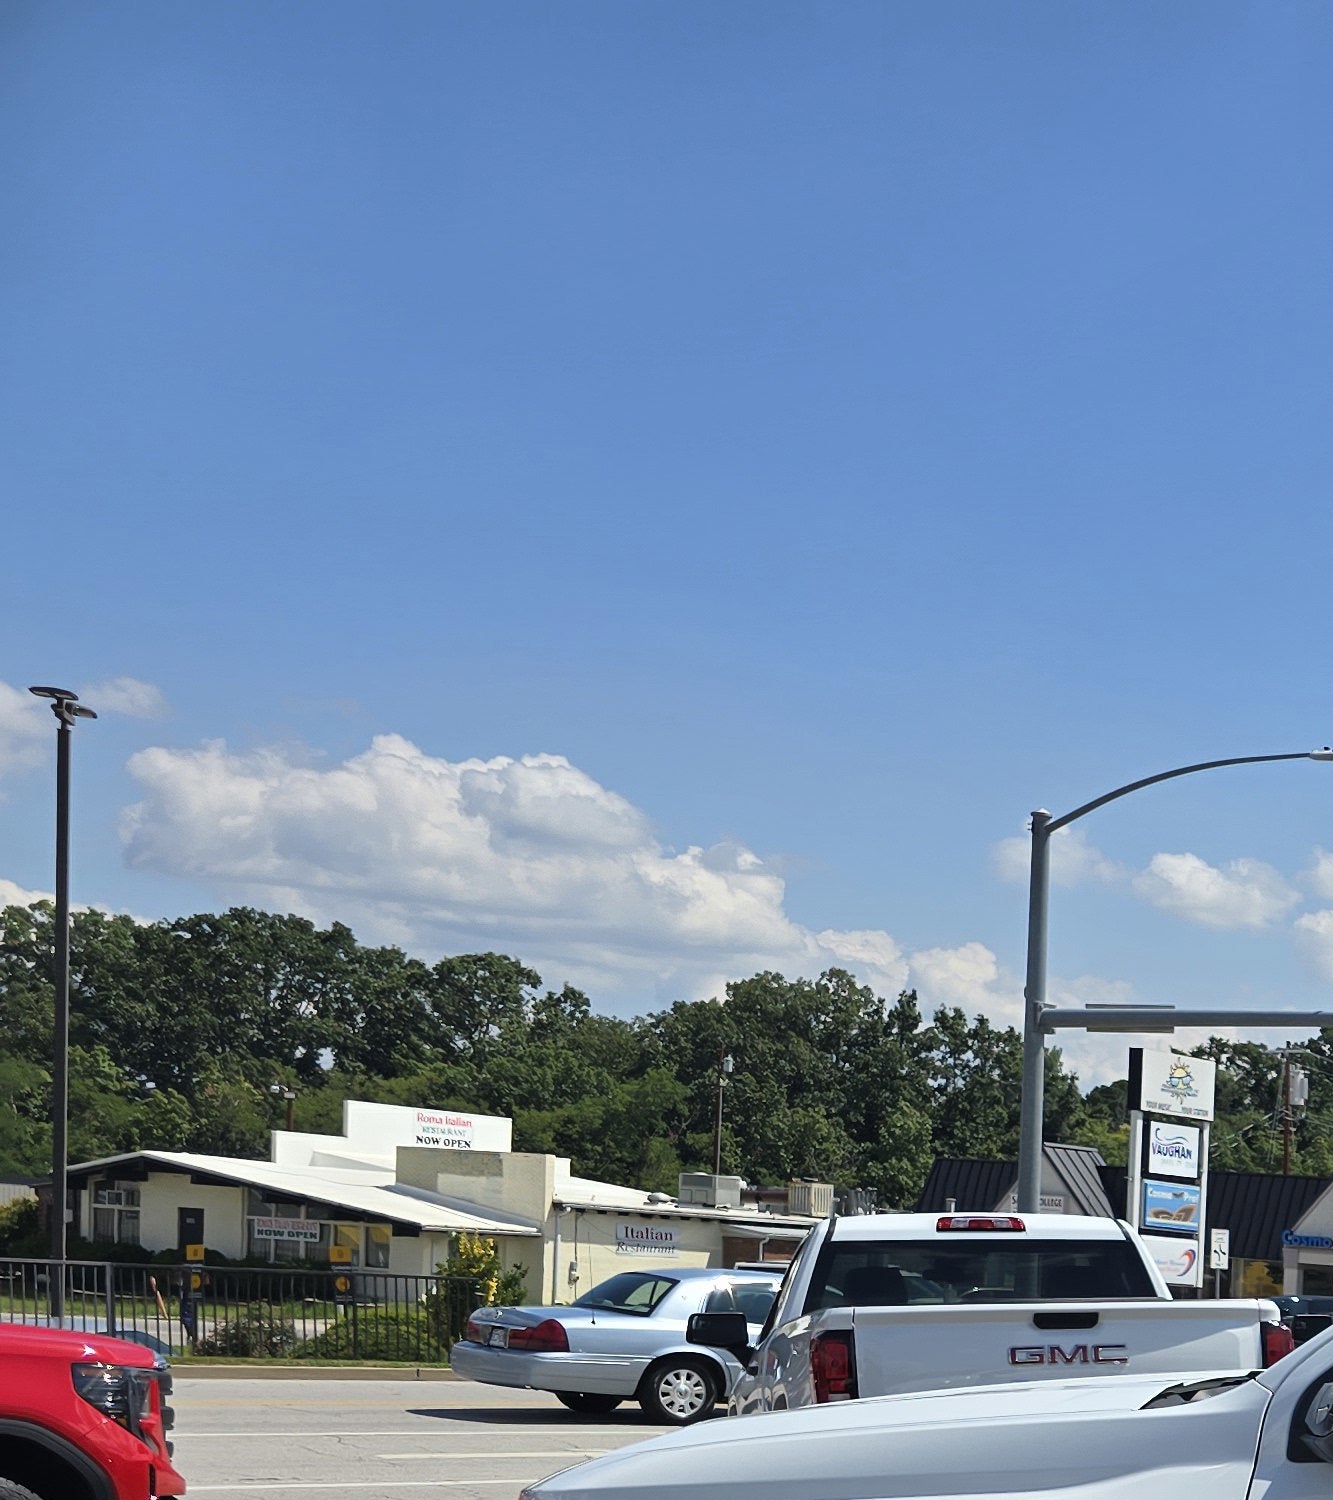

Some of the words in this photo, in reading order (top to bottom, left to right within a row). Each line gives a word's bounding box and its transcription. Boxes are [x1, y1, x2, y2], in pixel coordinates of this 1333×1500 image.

[417, 1112, 443, 1125] Roma
[445, 1115, 472, 1128] Italian
[416, 1135, 441, 1146] NOW
[443, 1138, 472, 1149] OPEN
[1151, 1142, 1193, 1160] VAUGHAN
[256, 1228, 285, 1238] NOW
[287, 1230, 318, 1240] OPEN
[624, 1226, 673, 1241] Italian
[1008, 1344, 1129, 1365] GMC
